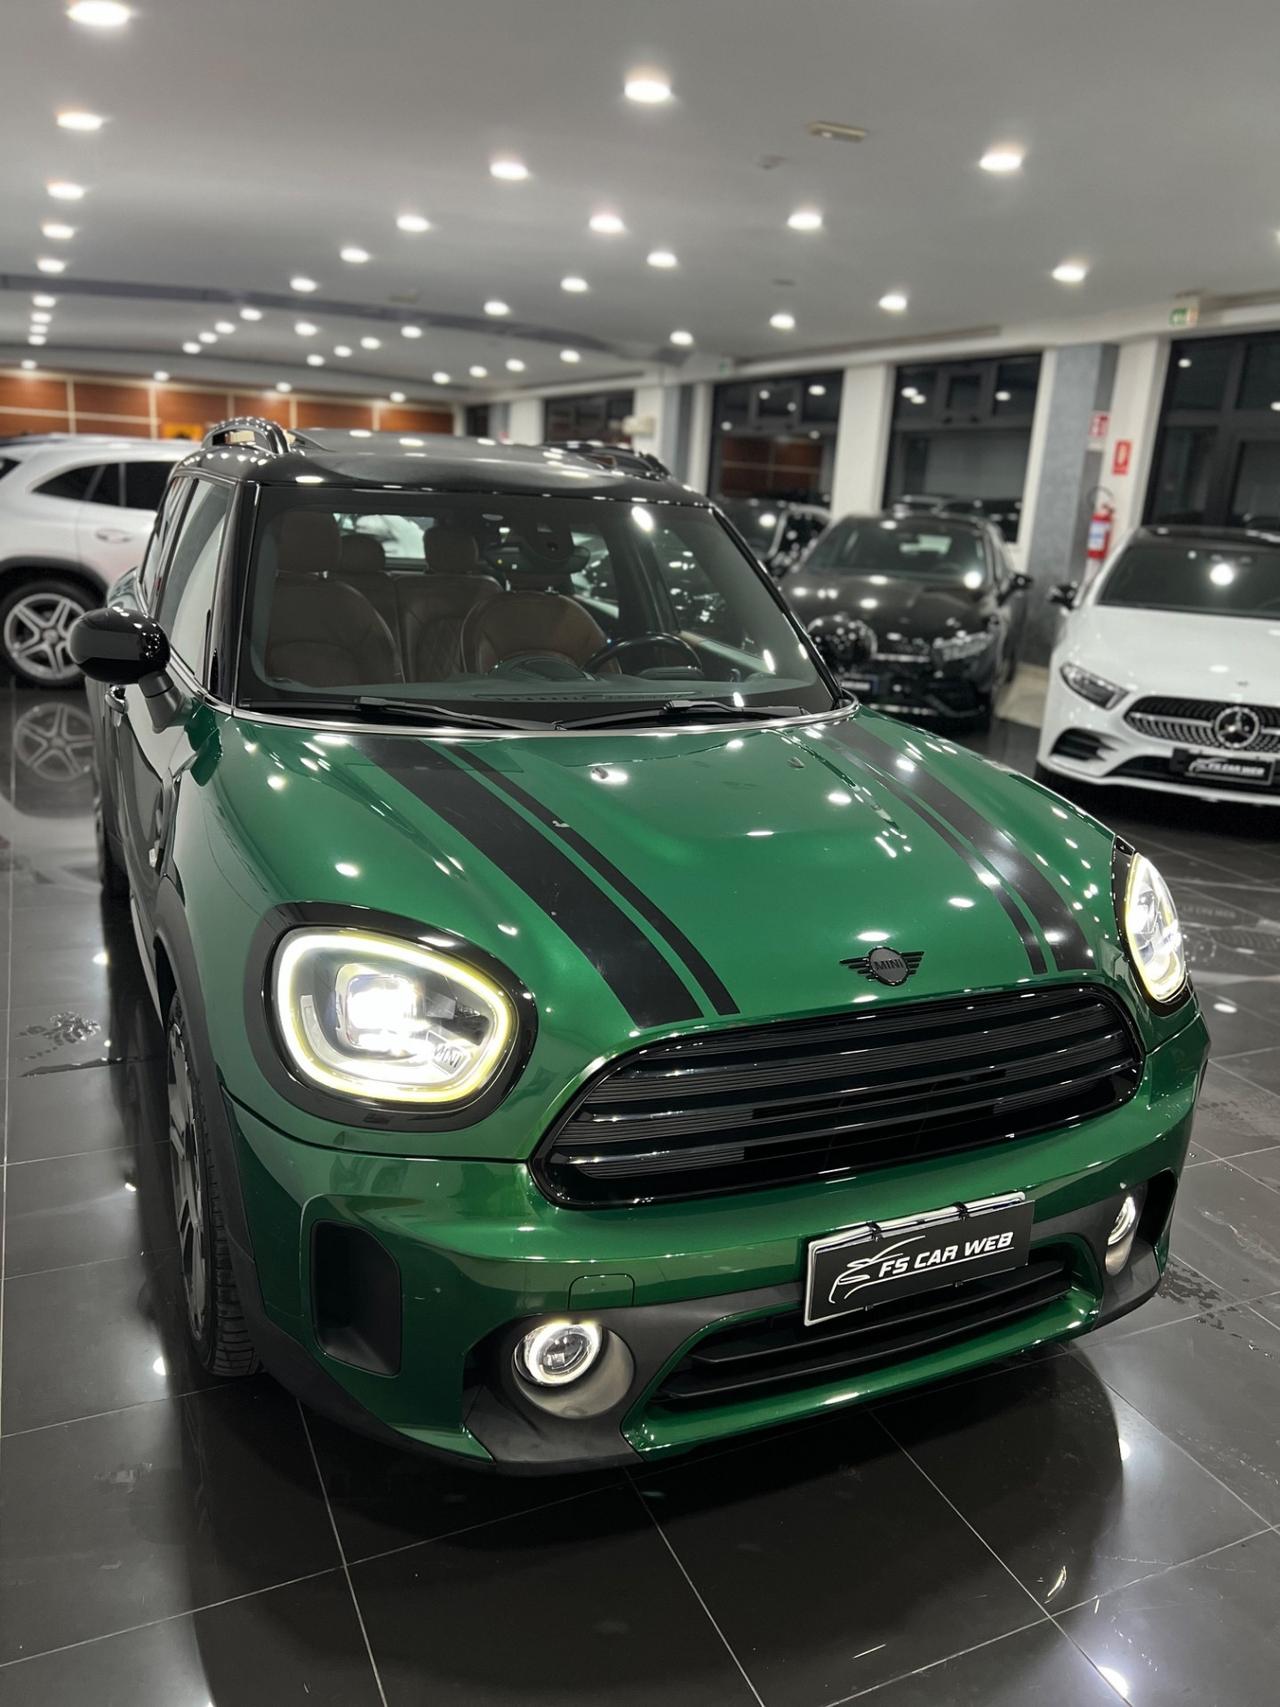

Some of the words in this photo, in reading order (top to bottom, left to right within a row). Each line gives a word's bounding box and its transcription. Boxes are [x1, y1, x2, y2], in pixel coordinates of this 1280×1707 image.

[874, 958, 905, 971] MINI
[878, 1256, 911, 1278] FS
[914, 1245, 959, 1269] CAR
[964, 1231, 1014, 1257] WEB
